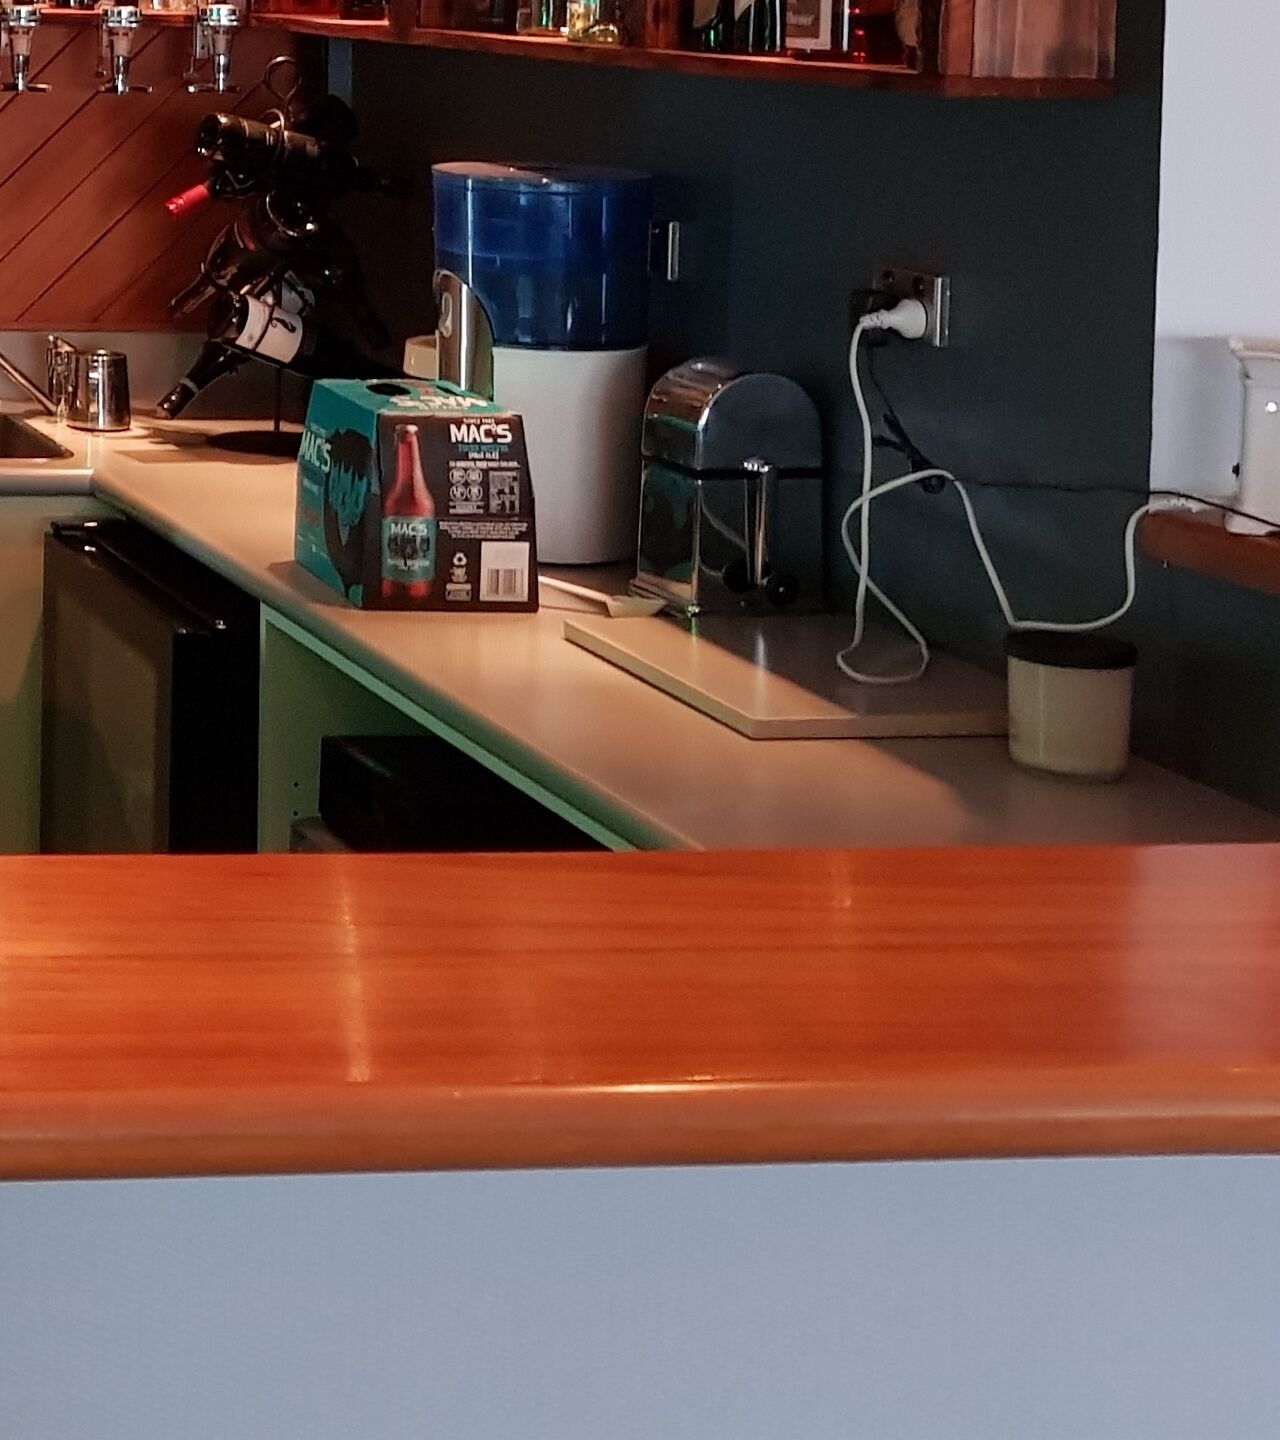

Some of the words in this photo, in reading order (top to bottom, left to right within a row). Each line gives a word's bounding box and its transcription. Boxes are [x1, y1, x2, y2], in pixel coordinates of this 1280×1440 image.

[449, 423, 513, 444] MAC'S
[301, 429, 332, 474] MAC'S
[390, 522, 427, 535] MAC'S
